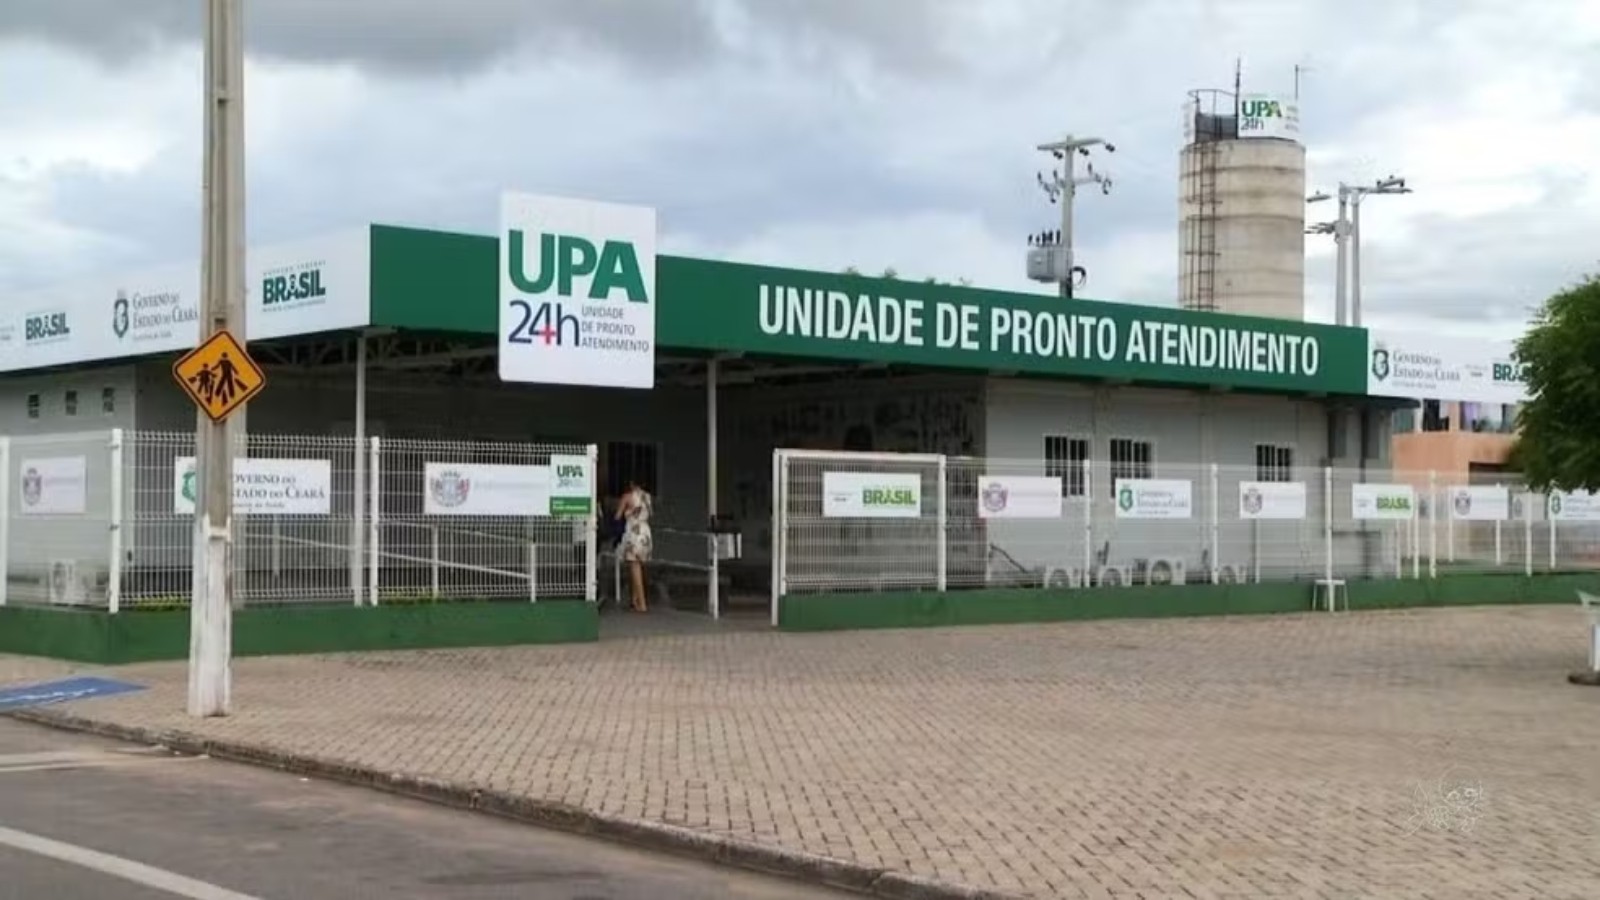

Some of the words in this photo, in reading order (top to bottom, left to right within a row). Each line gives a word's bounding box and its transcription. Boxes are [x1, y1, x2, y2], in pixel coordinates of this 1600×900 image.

[1241, 99, 1282, 118] UPA
[509, 228, 648, 304] UPA
[263, 269, 325, 305] BRASIL
[508, 299, 580, 348] 24h
[581, 305, 624, 319] UNIDADE
[26, 312, 70, 340] BRASIL
[581, 321, 595, 334] DE
[596, 322, 636, 336] PRONTO
[758, 284, 925, 348] UNIDADE
[934, 302, 980, 352] DE
[990, 306, 1118, 362] PRONTO
[1124, 321, 1321, 377] ATENDIMENTO
[581, 337, 650, 354] ATENDIMENTO
[862, 489, 917, 505] BRASIL
